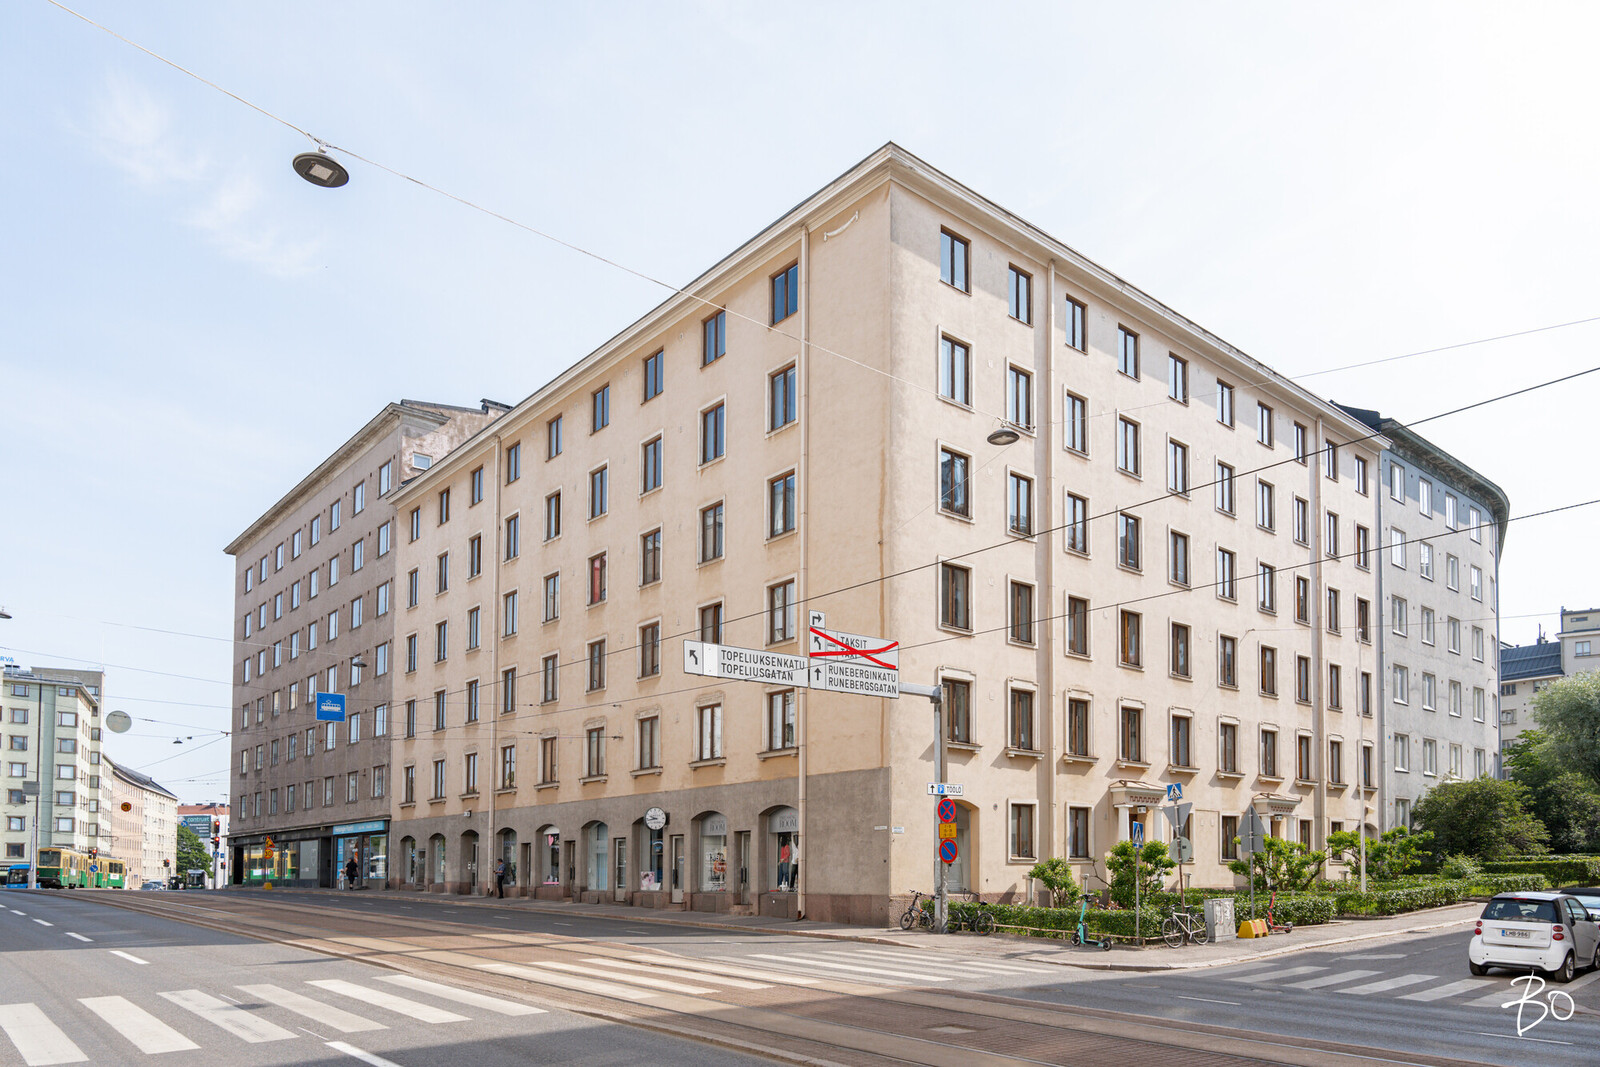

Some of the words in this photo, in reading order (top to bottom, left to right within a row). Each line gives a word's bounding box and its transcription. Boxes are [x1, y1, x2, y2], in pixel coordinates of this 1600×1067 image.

[721, 649, 805, 670] TOPELIUKSENKATU
[721, 663, 794, 681] TOPELIUSGATAN
[828, 665, 896, 683] RUNEBERGINKATU
[828, 676, 897, 694] RUNEBERGSGATAN
